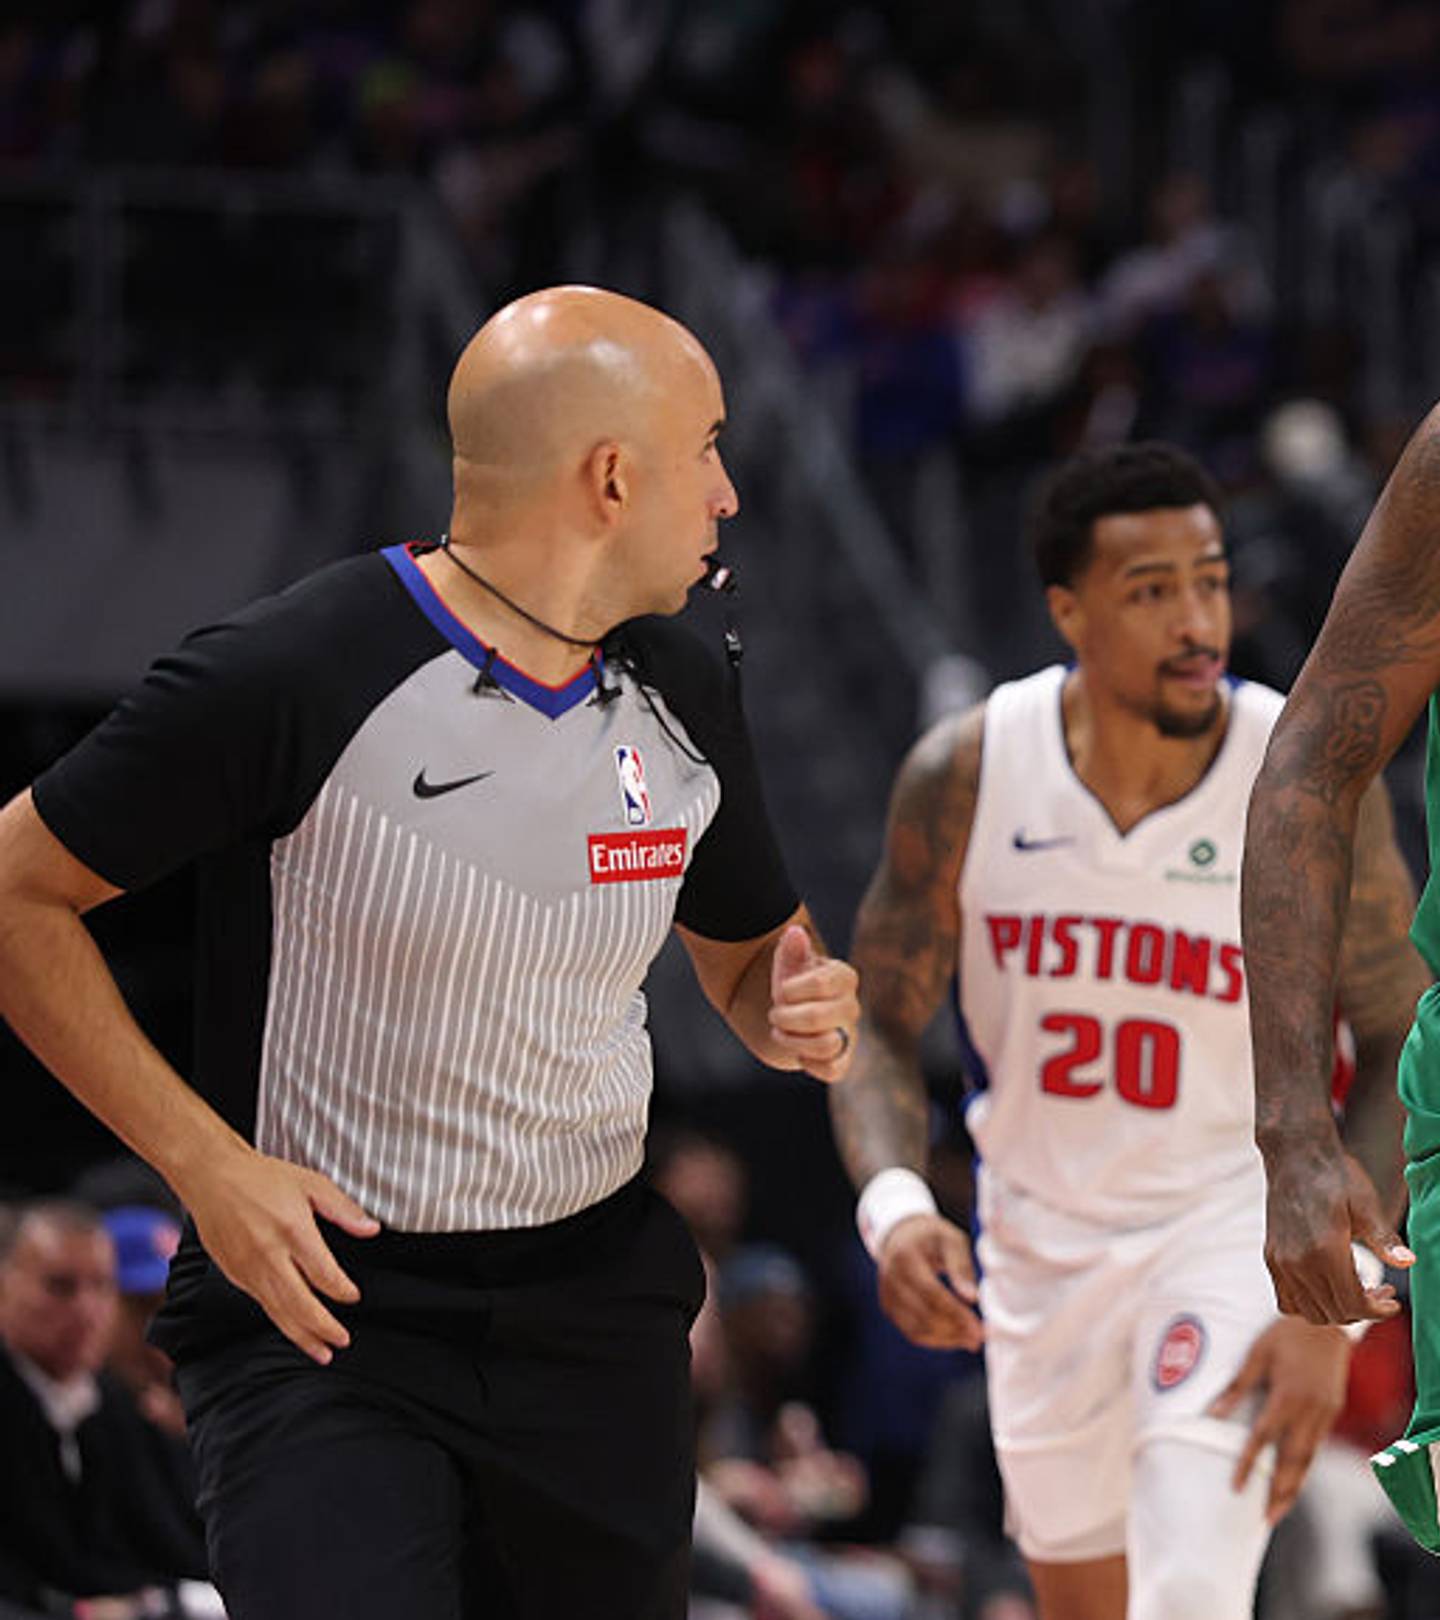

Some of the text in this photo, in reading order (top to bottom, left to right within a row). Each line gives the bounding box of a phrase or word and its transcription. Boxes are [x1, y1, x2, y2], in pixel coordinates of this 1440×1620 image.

[591, 841, 682, 873] Emirates
[986, 914, 1244, 1004] PISTONS
[1041, 1012, 1182, 1111] 20
